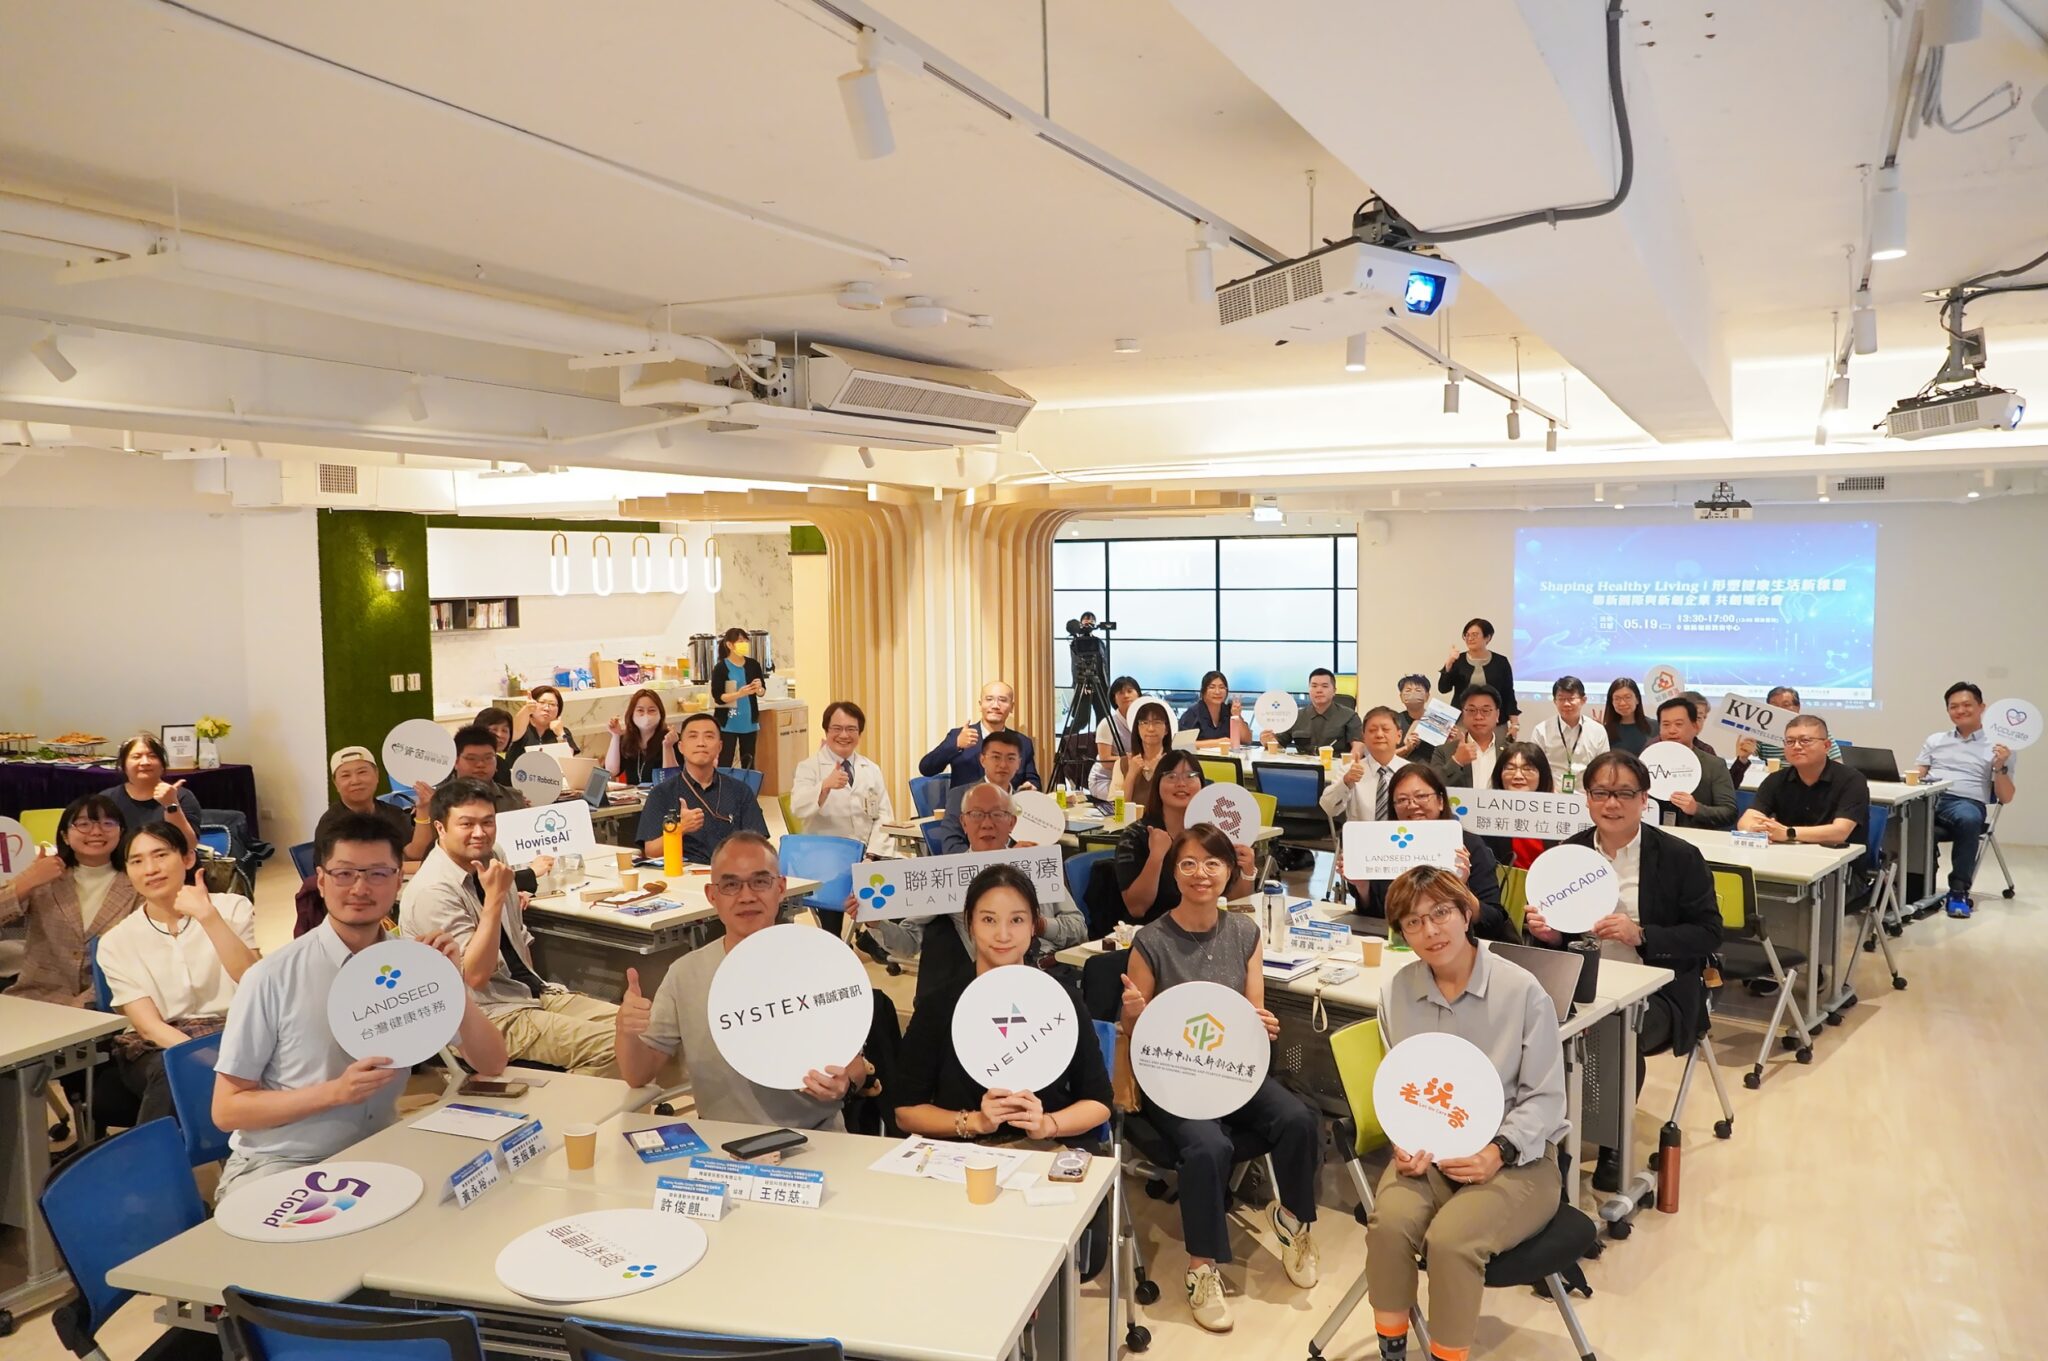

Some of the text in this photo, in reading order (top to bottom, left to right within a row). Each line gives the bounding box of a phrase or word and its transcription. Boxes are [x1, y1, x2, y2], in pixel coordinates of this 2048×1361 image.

[1540, 581, 1593, 593] Shaping
[1598, 581, 1651, 592] Healthy
[1655, 580, 1699, 593] Living
[1623, 618, 1658, 629] 05.19
[1726, 699, 1773, 730] KVQ
[537, 775, 560, 786] Robotics
[1476, 797, 1580, 815] LANDSEED
[515, 830, 570, 851] HowiseAI
[1365, 854, 1411, 862] LANDSEED
[903, 857, 1060, 893] 聯新國醫療
[352, 981, 440, 1022] LANDSEED
[719, 984, 862, 1030] SYSTEX 精誠資訊
[359, 1000, 446, 1041] 台灣健康特務
[986, 1012, 1066, 1077] NEUINX
